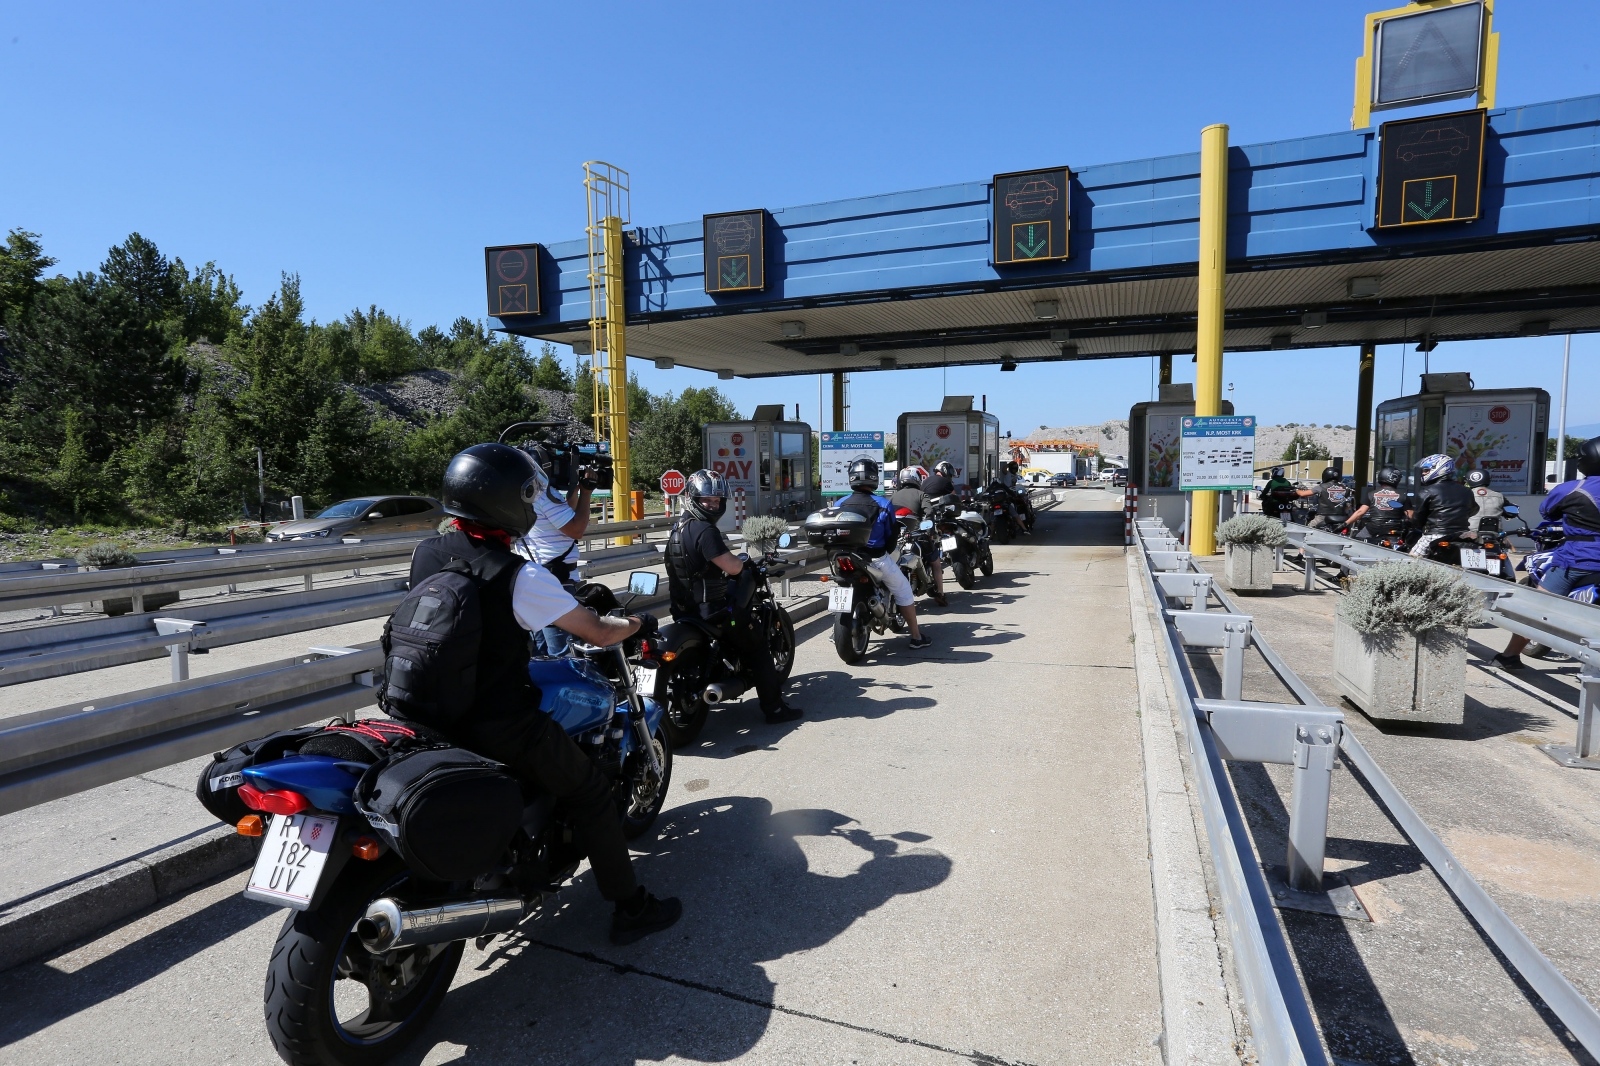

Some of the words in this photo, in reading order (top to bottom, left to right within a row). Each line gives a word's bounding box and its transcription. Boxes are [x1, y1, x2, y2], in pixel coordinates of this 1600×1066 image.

[1492, 411, 1507, 419] STOP
[713, 461, 753, 480] PAY
[663, 478, 683, 488] STOP
[637, 674, 652, 683] 677
[563, 689, 604, 706] Kawasaki
[279, 815, 307, 840] RI
[278, 840, 311, 868] 182
[269, 865, 301, 893] UV
